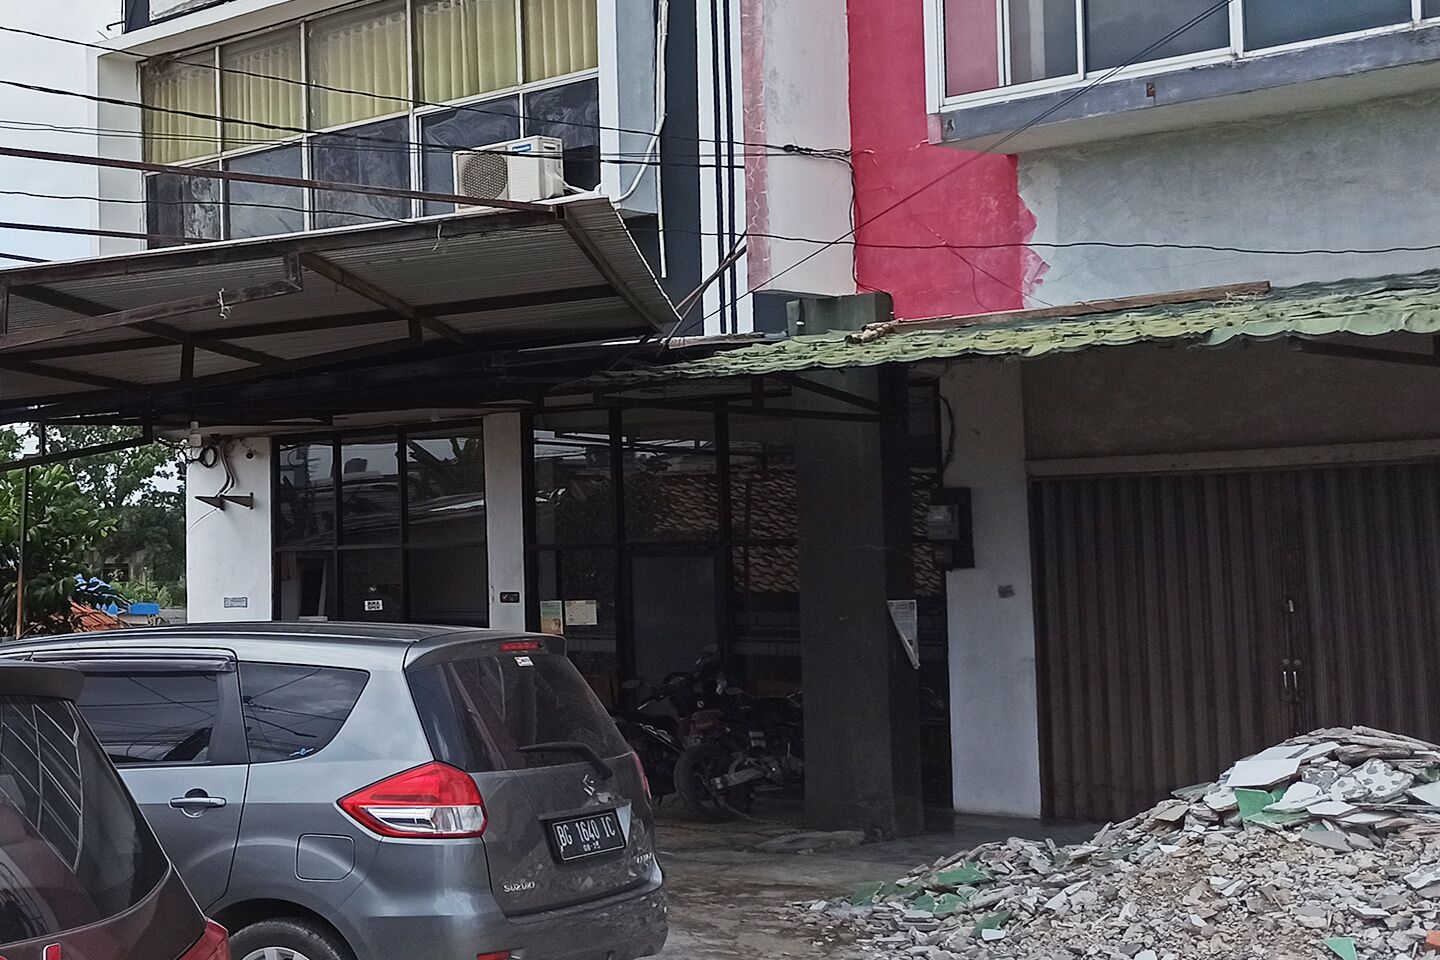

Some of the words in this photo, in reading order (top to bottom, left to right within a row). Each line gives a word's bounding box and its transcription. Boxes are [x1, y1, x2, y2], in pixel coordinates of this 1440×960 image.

[555, 824, 573, 847] BG
[575, 819, 600, 842] 1640
[600, 816, 616, 838] IC
